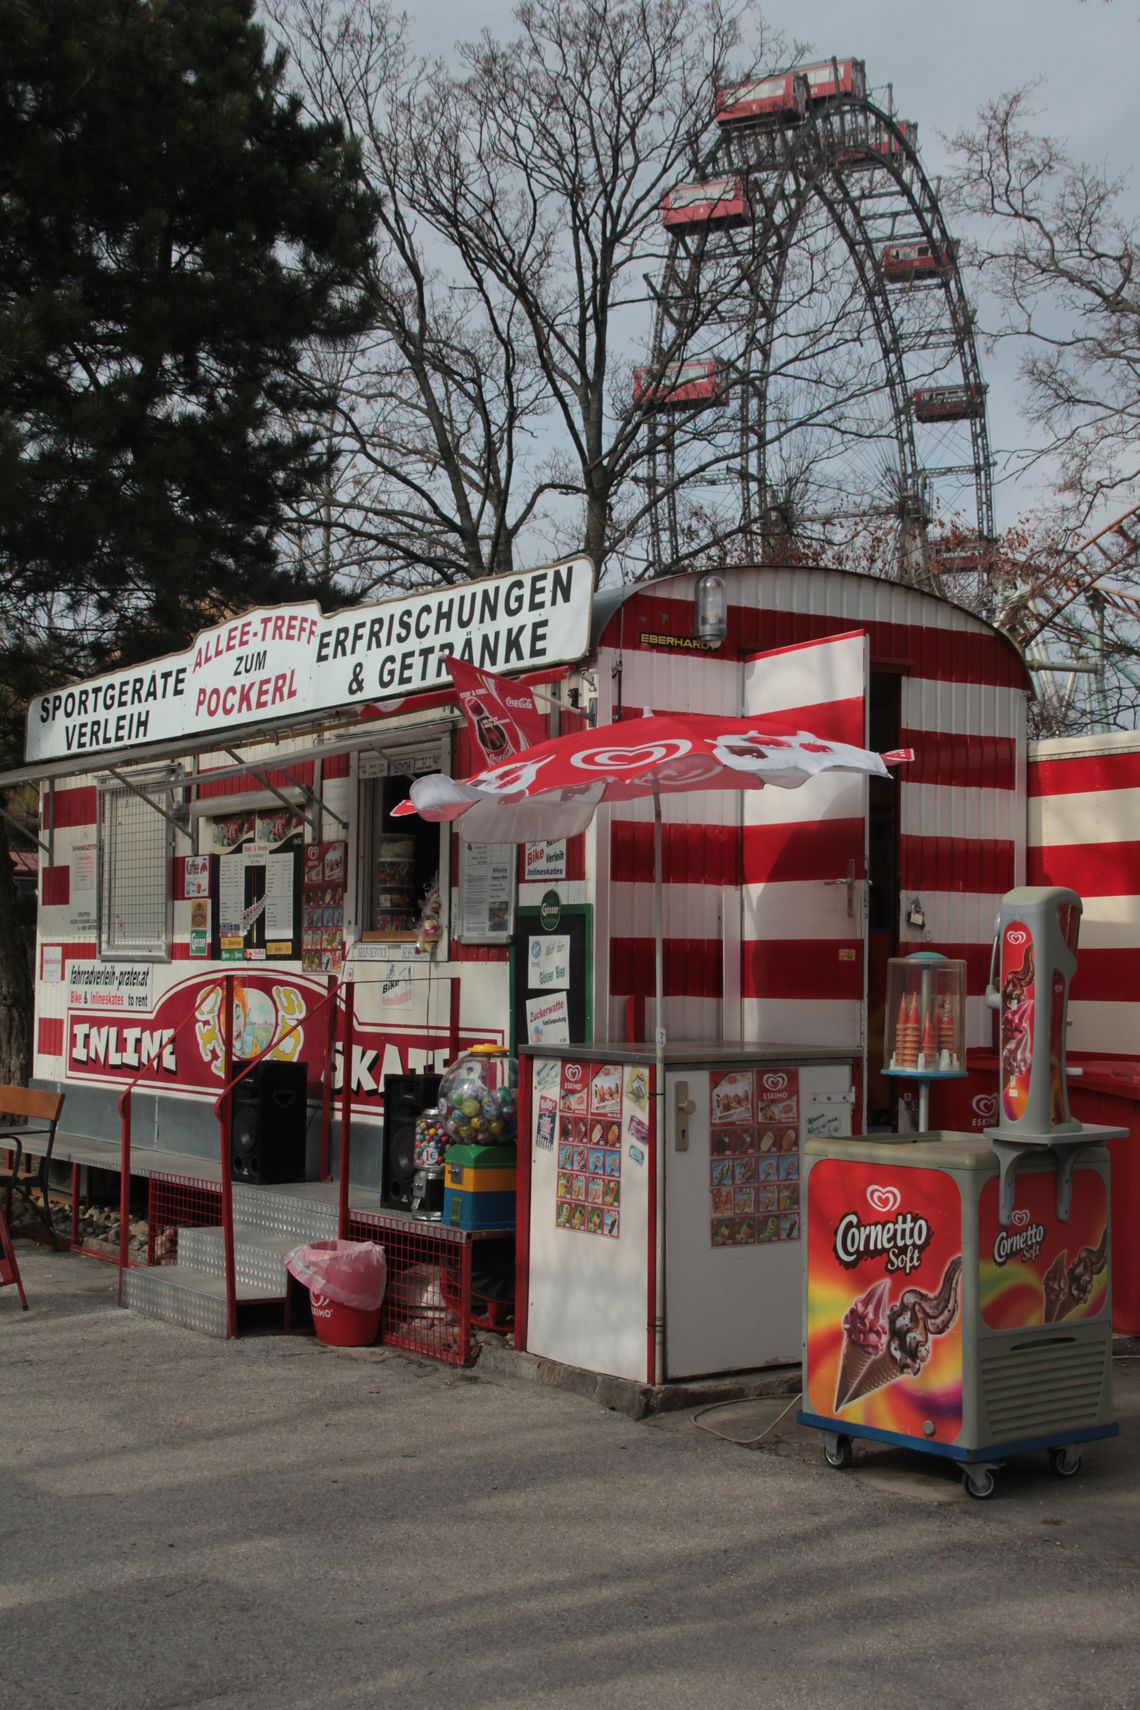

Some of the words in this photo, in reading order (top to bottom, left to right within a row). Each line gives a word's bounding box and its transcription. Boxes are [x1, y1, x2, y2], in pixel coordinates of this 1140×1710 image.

[316, 565, 574, 664] ERFRISCHUNGEN
[193, 615, 318, 674] ALLEE-TREFF
[347, 661, 365, 695] &
[378, 618, 549, 690] GETRÄNKE
[233, 650, 267, 676] ZUM
[195, 668, 298, 717] POCKERL
[506, 696, 533, 710] Coca-Cola
[65, 710, 150, 751] VERLEIH
[527, 848, 544, 867] Bike
[526, 867, 564, 876] Inlineskates
[70, 991, 82, 1004] Bike
[91, 992, 124, 1006] Inlineskates
[128, 993, 133, 1006] to
[135, 994, 148, 1007] rent
[529, 1000, 564, 1022] Zuckerwatte
[72, 1023, 176, 1074] INLINE
[763, 1092, 788, 1100] ESKIMO
[836, 1213, 928, 1262] Cornetto
[994, 1225, 1044, 1262] Cornetto
[887, 1246, 921, 1273] Soft
[1023, 1244, 1040, 1261] Soft
